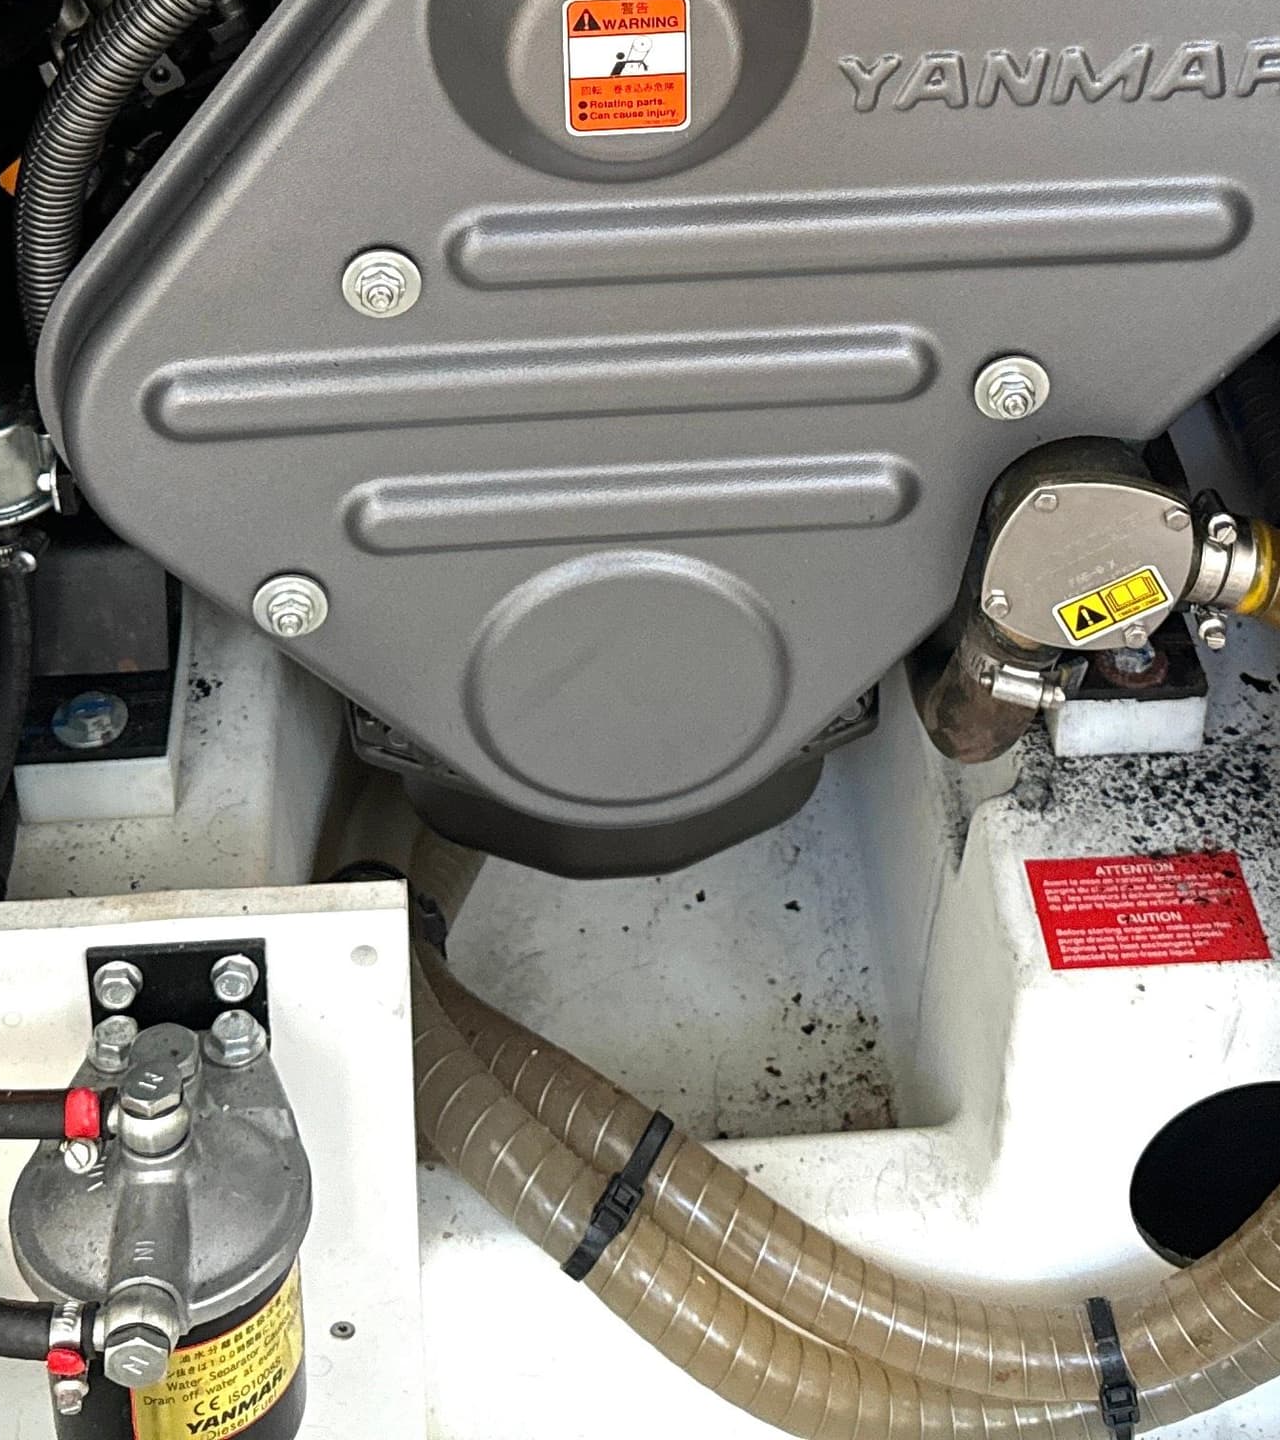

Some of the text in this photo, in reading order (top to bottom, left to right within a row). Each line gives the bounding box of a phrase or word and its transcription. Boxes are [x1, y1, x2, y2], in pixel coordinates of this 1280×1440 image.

[621, 1, 649, 15] 警告
[602, 15, 679, 31] WARNING
[589, 100, 634, 110] Rotating
[589, 111, 611, 121] Can
[613, 110, 644, 120] cause
[1095, 862, 1175, 877] ATTENTION
[1116, 910, 1183, 925] CAUTION
[143, 1339, 282, 1407] Drain off water at every
[166, 1376, 204, 1393] Water
[209, 1346, 261, 1381] Separator
[206, 1390, 278, 1440] Diesel Fuel
